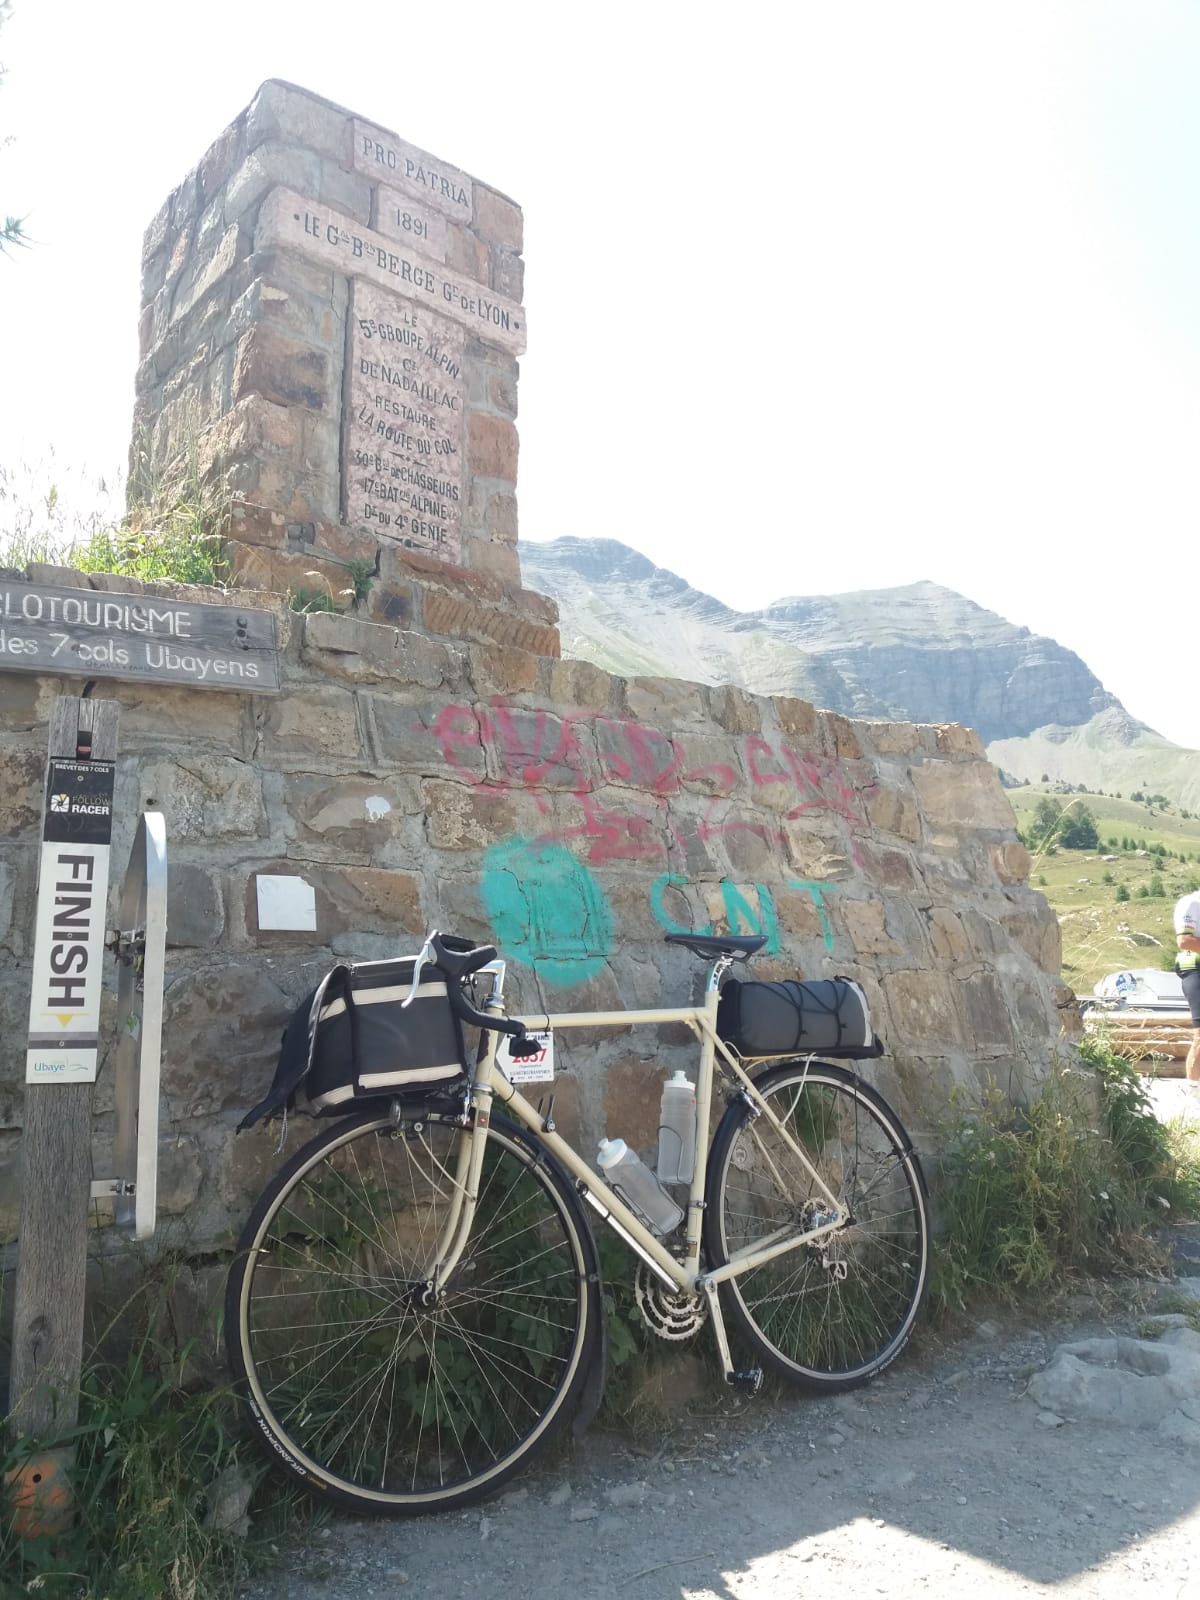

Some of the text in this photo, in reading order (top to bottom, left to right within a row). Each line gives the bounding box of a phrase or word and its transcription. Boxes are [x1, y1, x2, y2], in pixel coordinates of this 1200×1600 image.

[363, 135, 469, 209] PRO PATRIA
[397, 207, 428, 240] 1891
[304, 212, 320, 238] LE
[376, 247, 435, 294] BERGE
[461, 296, 476, 314] DE
[478, 298, 510, 331] LYON
[404, 311, 418, 328] LE
[360, 358, 378, 379] DE
[378, 323, 424, 351] GROUPE
[424, 345, 460, 380] ALPIN
[358, 405, 457, 456] LA ROUTE DU COL
[401, 466, 459, 501] CHASSEURS
[410, 494, 448, 520] ALPINE
[378, 511, 391, 525] DU
[411, 518, 448, 544] GENIE
[0, 591, 192, 638] LOTOURISME
[48, 632, 70, 658] 7
[78, 640, 129, 665] cols
[146, 643, 260, 680] Ubayens
[71, 804, 110, 815] RACER
[47, 853, 96, 1008] FINISH
[34, 1062, 65, 1073] Ubaye
